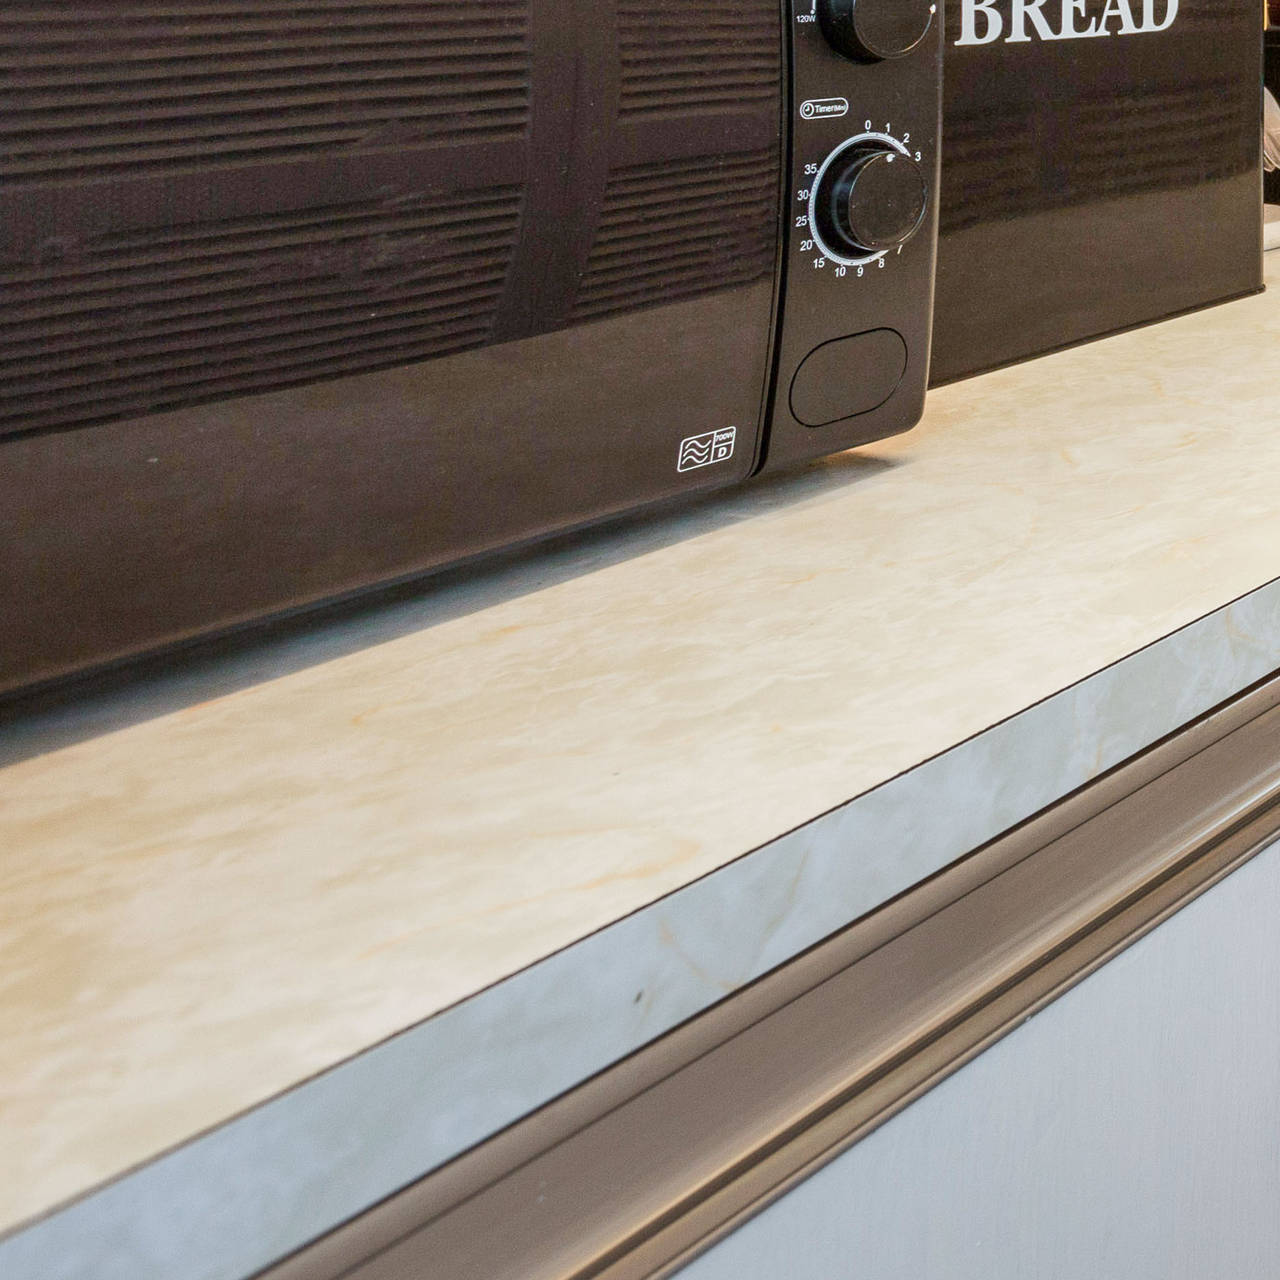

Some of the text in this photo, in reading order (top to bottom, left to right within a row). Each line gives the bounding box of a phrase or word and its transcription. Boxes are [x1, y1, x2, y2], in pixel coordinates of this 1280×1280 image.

[796, 15, 816, 23] 120W
[864, 119, 872, 130] 0
[885, 122, 891, 132] 1
[903, 133, 910, 143] 2
[915, 151, 922, 161] 3
[804, 163, 817, 175] 35
[797, 189, 809, 201] 30
[795, 215, 807, 227] 25
[800, 240, 813, 251] 20
[813, 258, 825, 268] 15
[878, 258, 885, 268] 8
[835, 266, 846, 277] 10
[857, 267, 864, 277] 9
[718, 447, 727, 457] D
